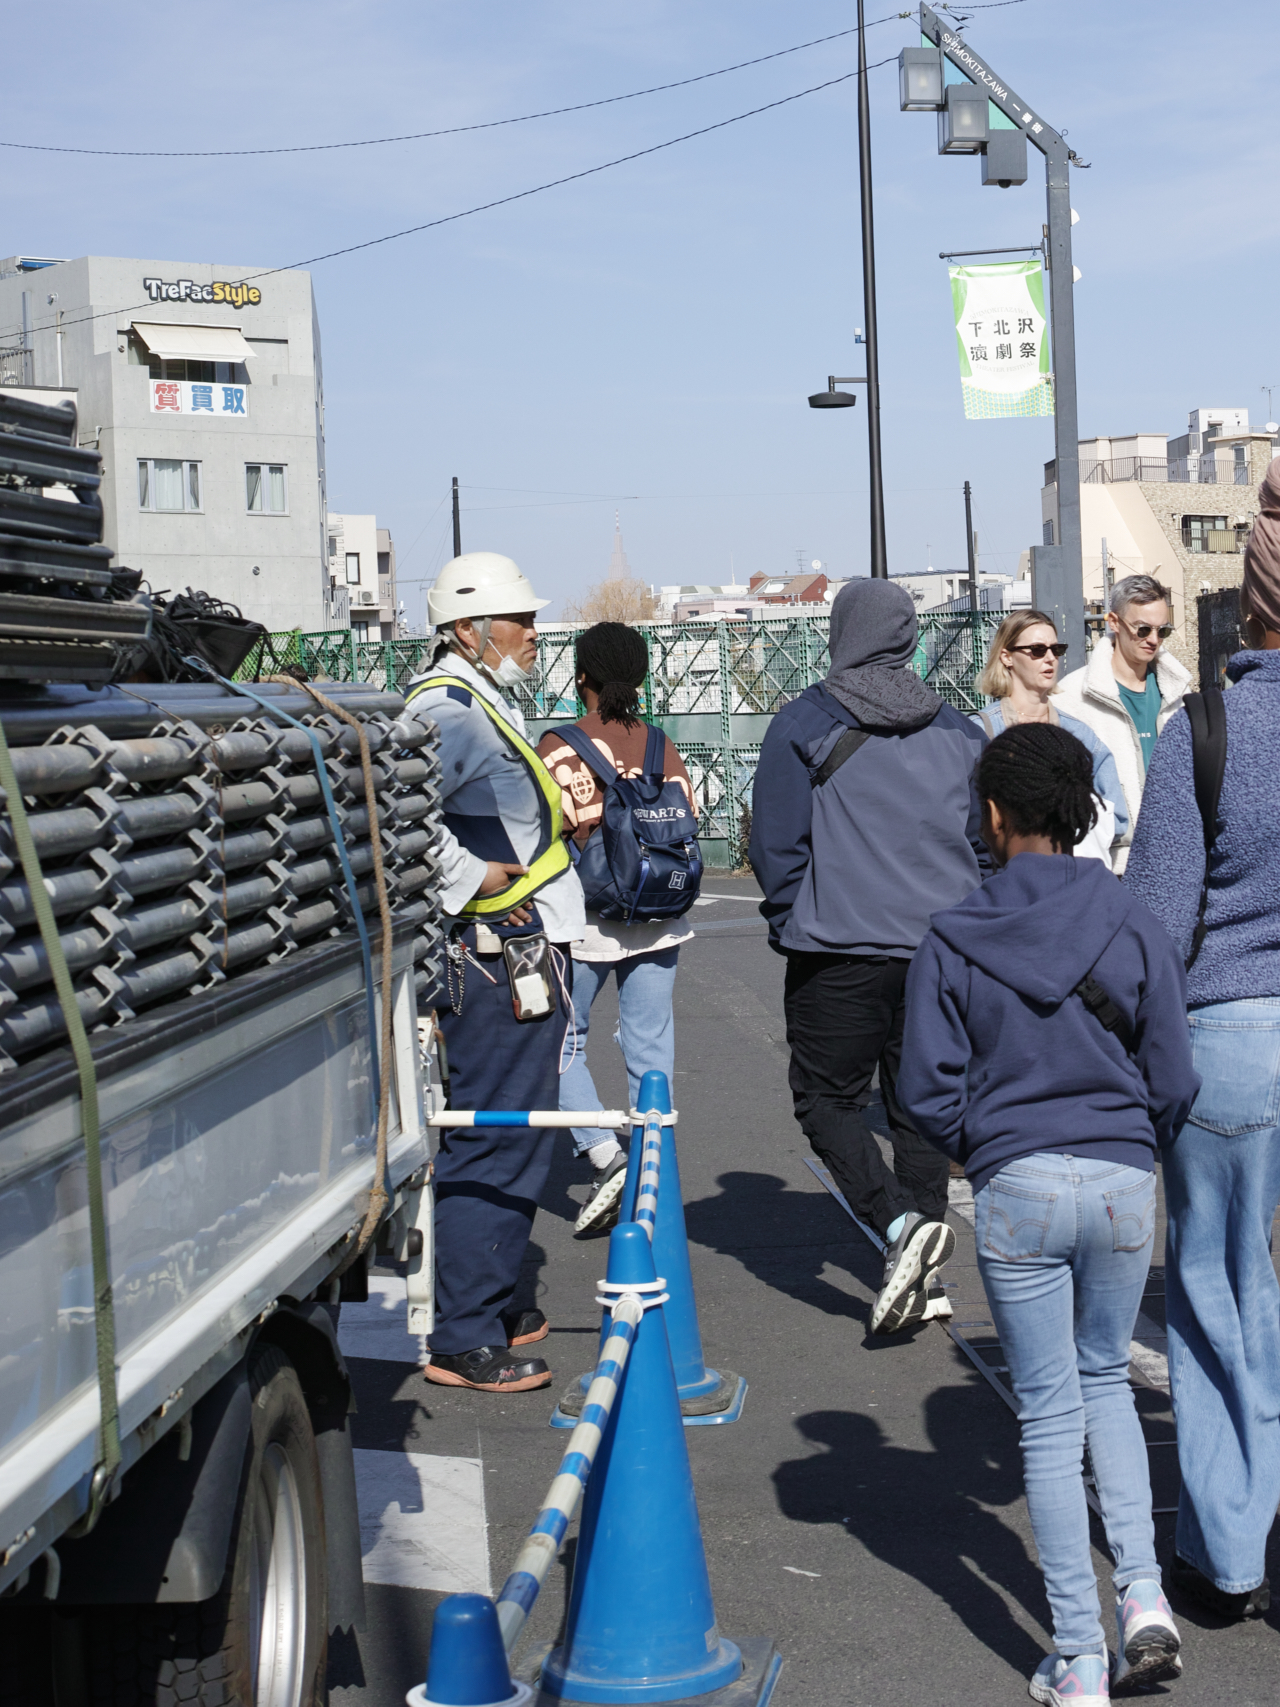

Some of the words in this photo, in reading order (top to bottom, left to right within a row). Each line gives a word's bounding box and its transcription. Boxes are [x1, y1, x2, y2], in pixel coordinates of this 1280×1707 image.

[941, 33, 1008, 102] SHIMOKITAZAWA
[1012, 103, 1044, 134] 一番街
[144, 278, 261, 308] TreFacStyle
[968, 317, 1035, 338] 下北沢
[970, 342, 1037, 362] 演劇祭
